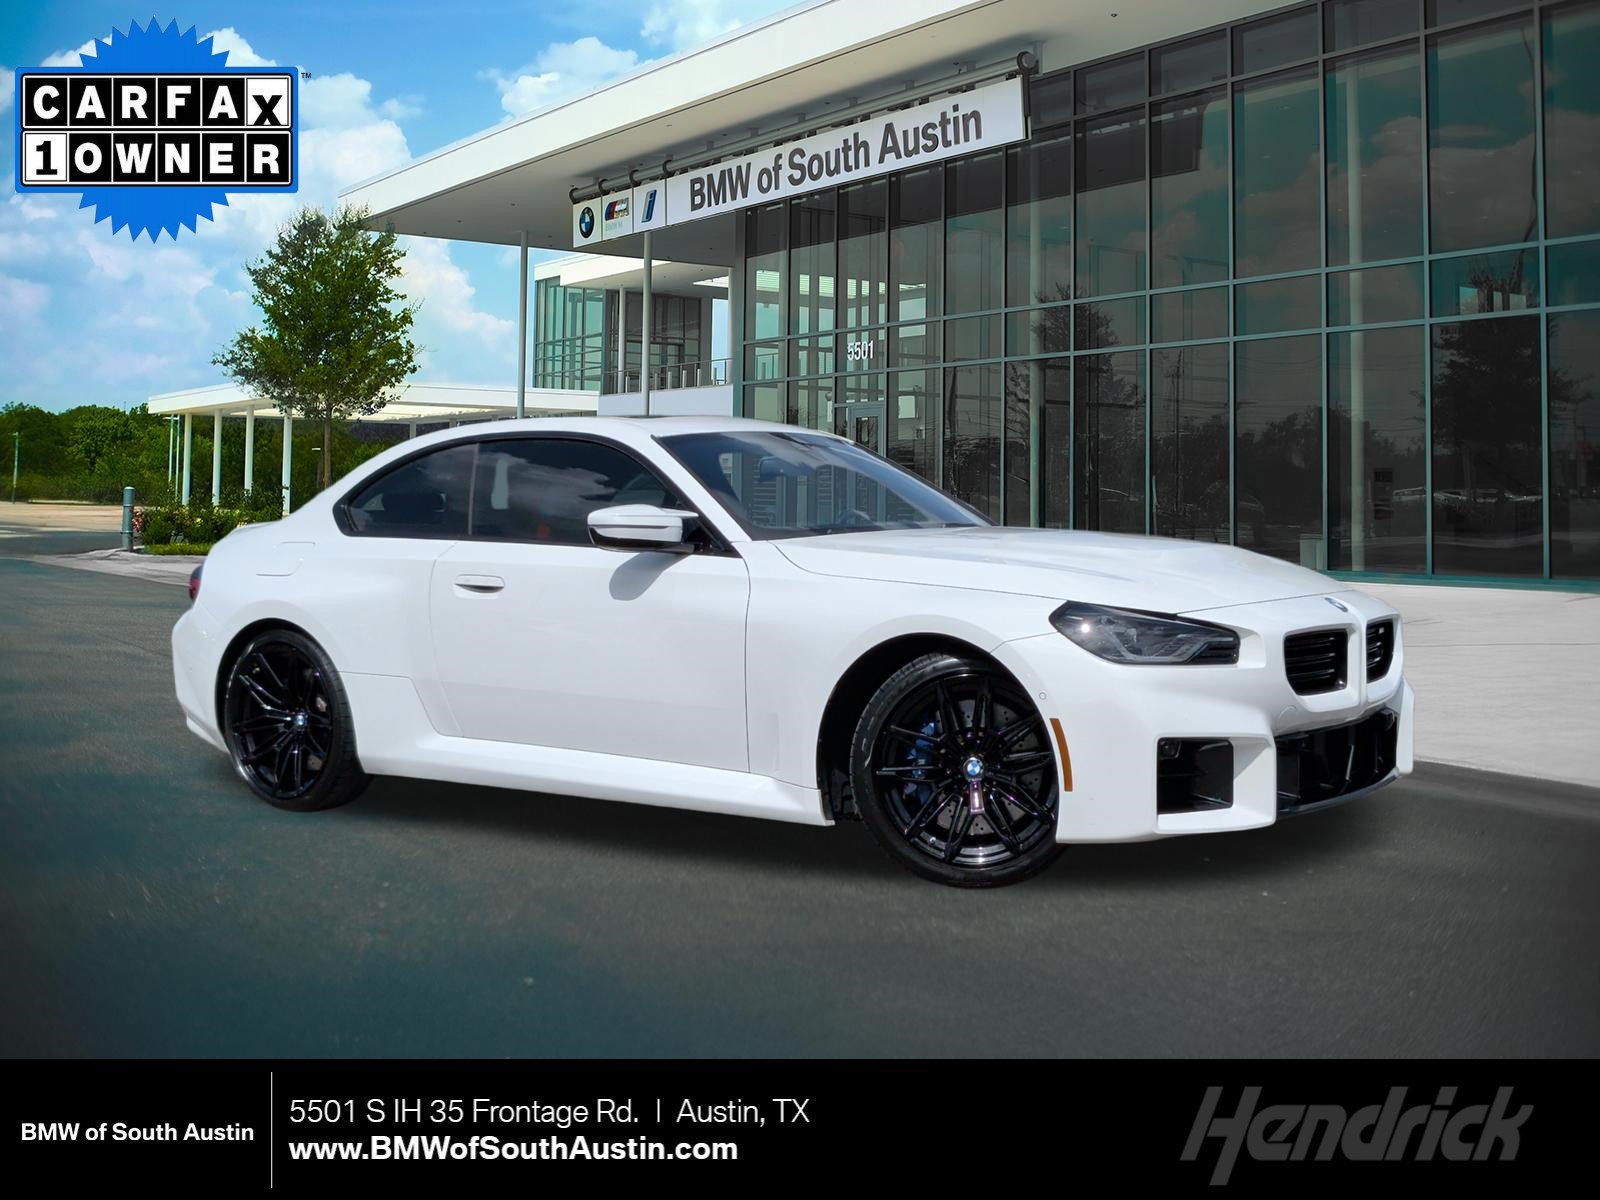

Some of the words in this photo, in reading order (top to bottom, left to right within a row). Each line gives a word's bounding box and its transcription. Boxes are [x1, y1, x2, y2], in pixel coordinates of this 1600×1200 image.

[690, 162, 752, 212] BMW
[757, 153, 783, 194] of
[787, 132, 870, 187] South
[878, 104, 983, 164] Austin
[847, 340, 875, 361] 5501
